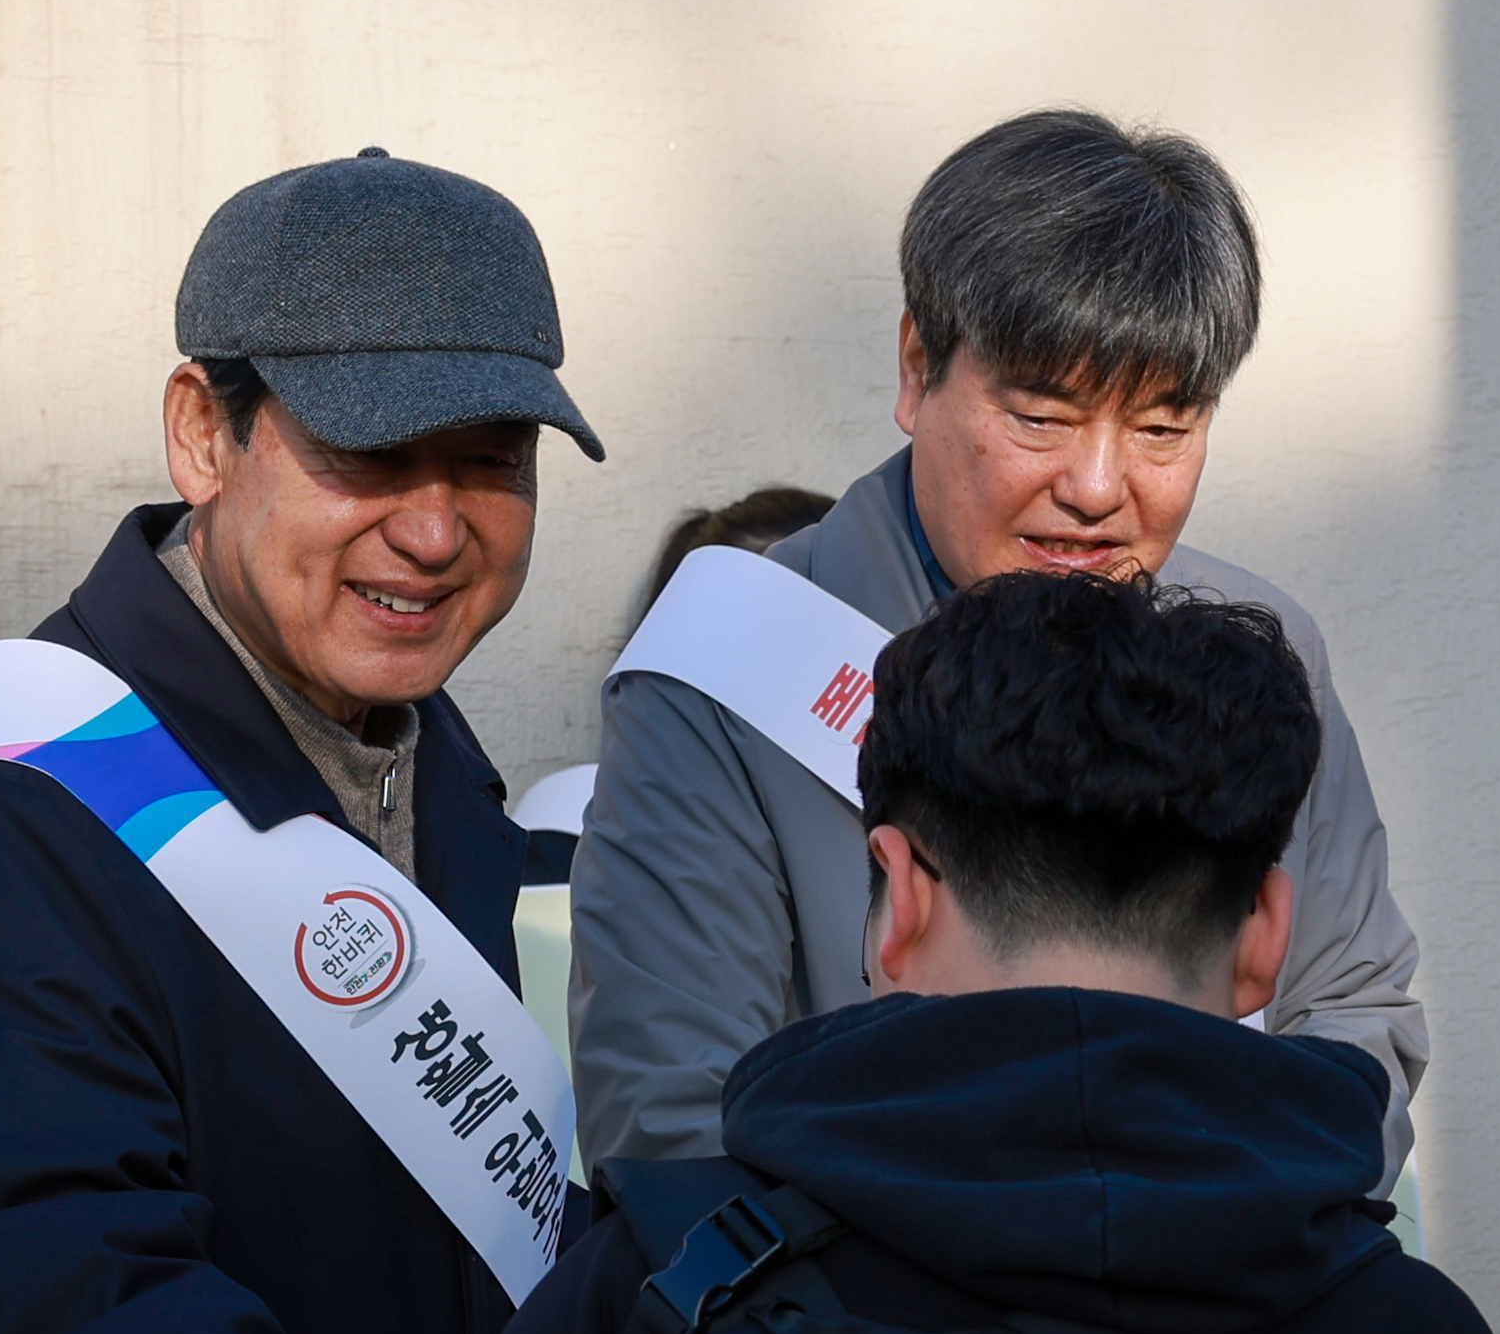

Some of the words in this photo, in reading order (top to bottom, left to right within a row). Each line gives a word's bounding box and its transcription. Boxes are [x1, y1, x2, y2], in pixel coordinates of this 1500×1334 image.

[312, 906, 354, 951] 안전
[319, 916, 385, 979] 한바퀴
[390, 1000, 519, 1138] 생활속
